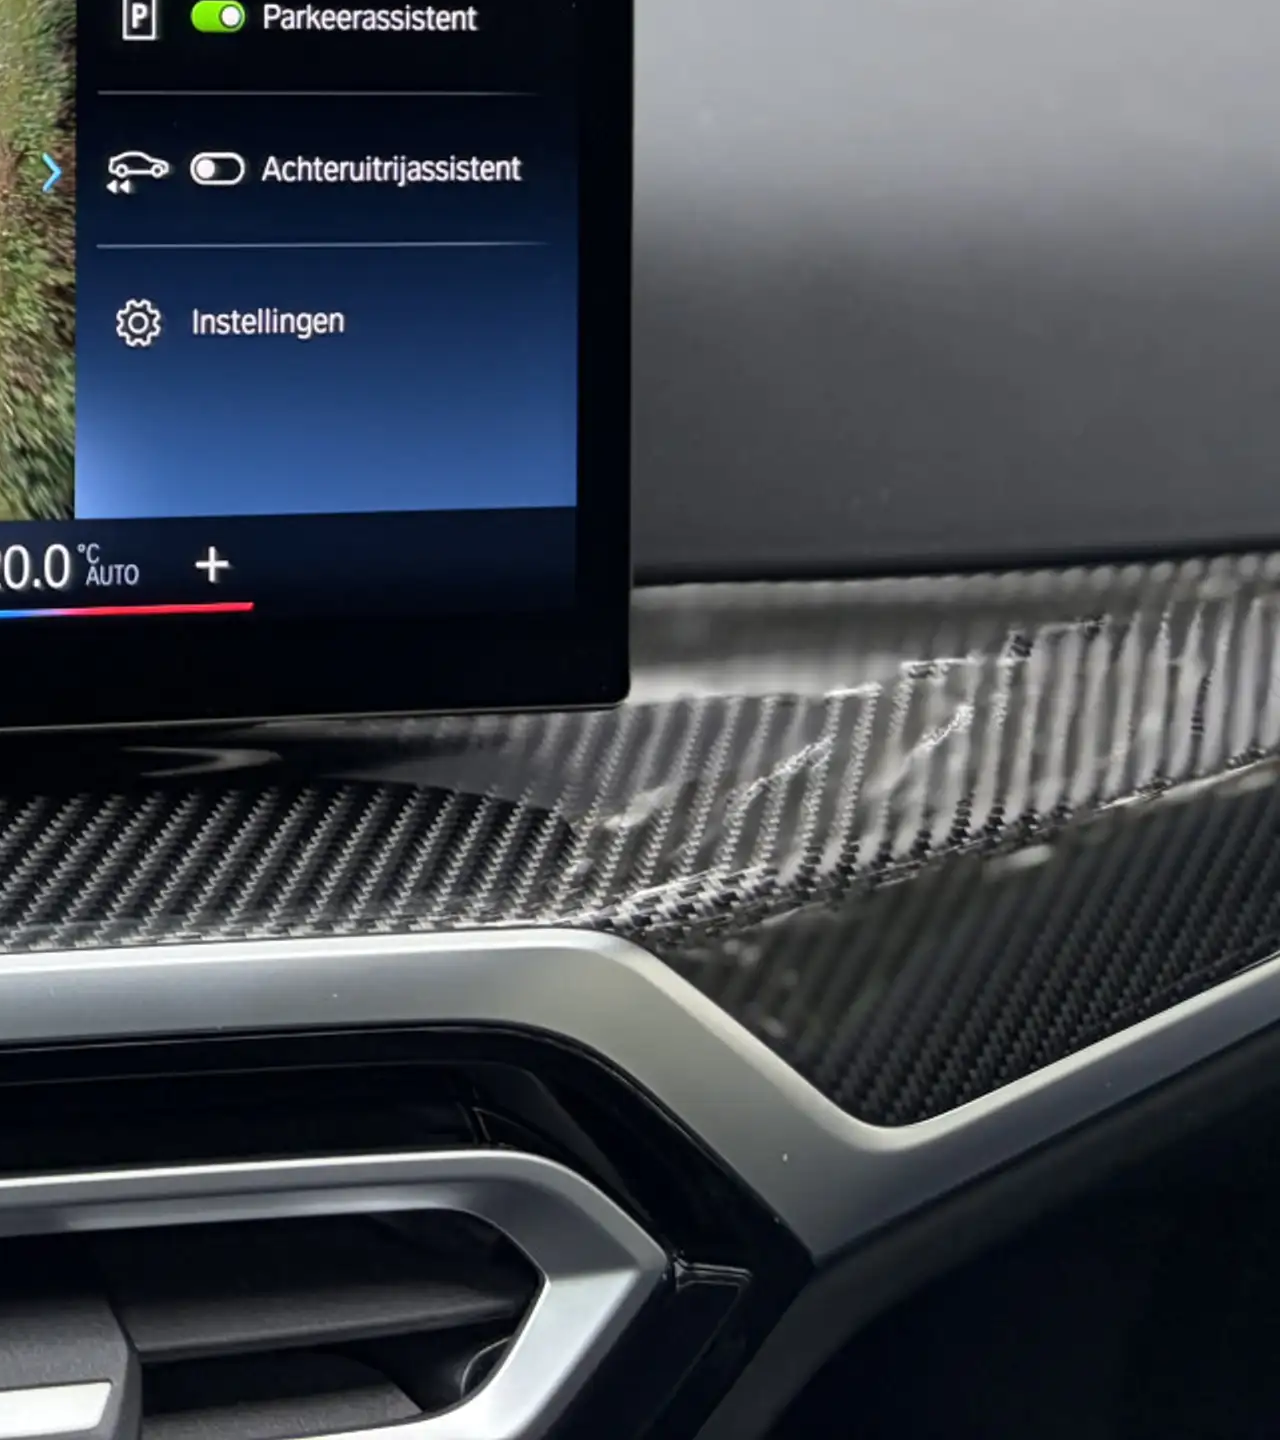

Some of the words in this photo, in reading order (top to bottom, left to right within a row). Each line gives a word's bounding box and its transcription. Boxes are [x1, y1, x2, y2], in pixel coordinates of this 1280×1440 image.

[262, 2, 479, 33] Parkeerassistent
[260, 154, 523, 189] Achteruitrijassistent
[191, 306, 346, 344] Instellingen
[85, 564, 139, 586] AUTO
